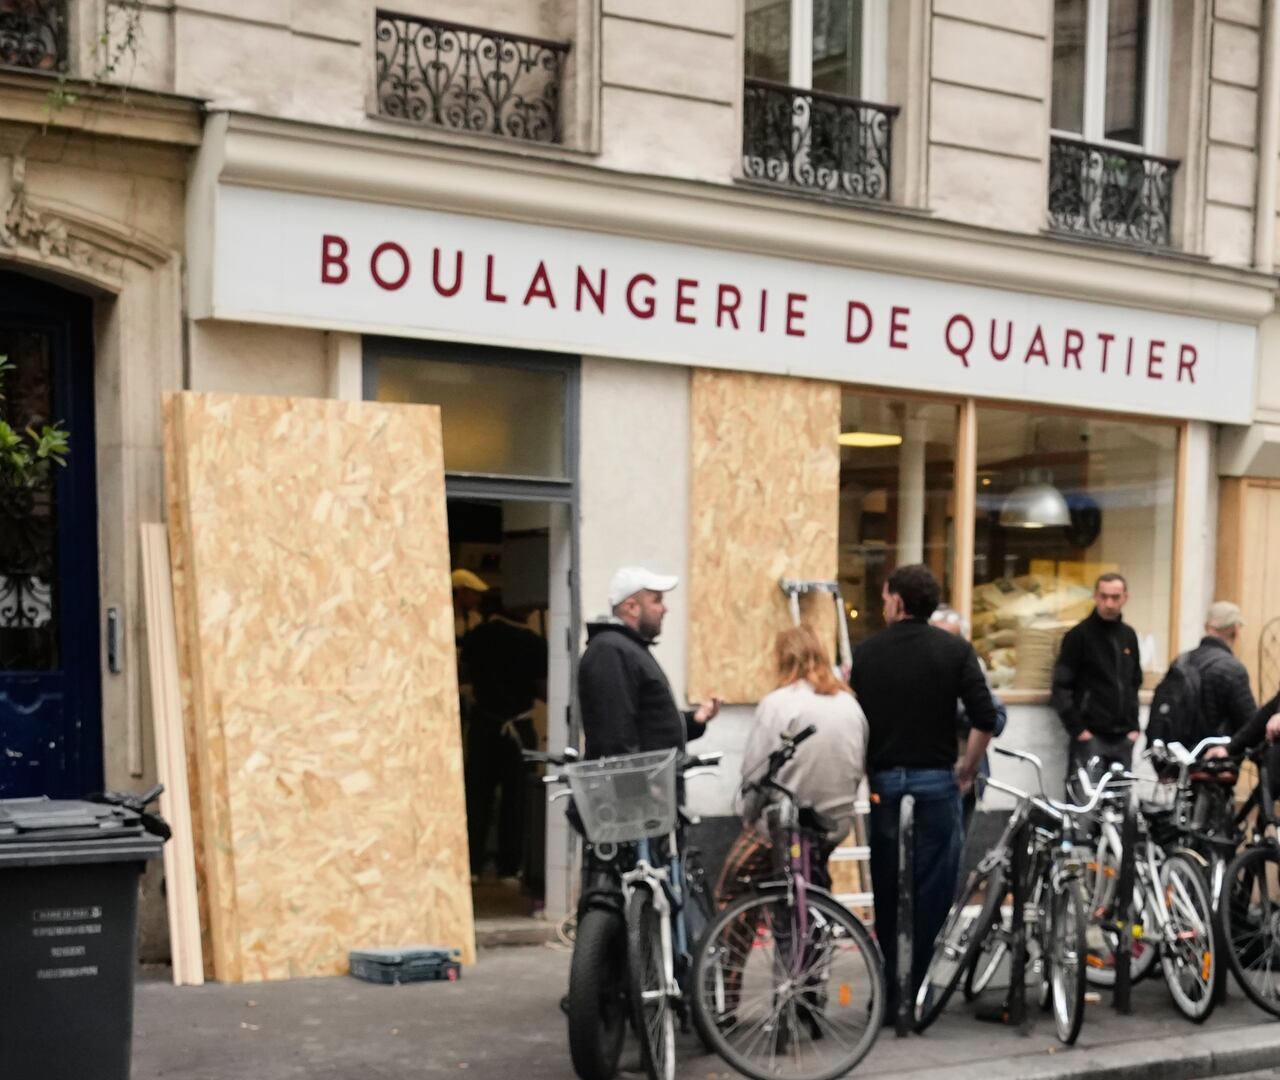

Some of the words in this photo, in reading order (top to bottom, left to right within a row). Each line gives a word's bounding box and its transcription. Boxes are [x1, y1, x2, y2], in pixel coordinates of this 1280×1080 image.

[320, 234, 808, 338] BOULANGERIE
[846, 300, 911, 350] DE
[945, 313, 1198, 384] QUARTIER
